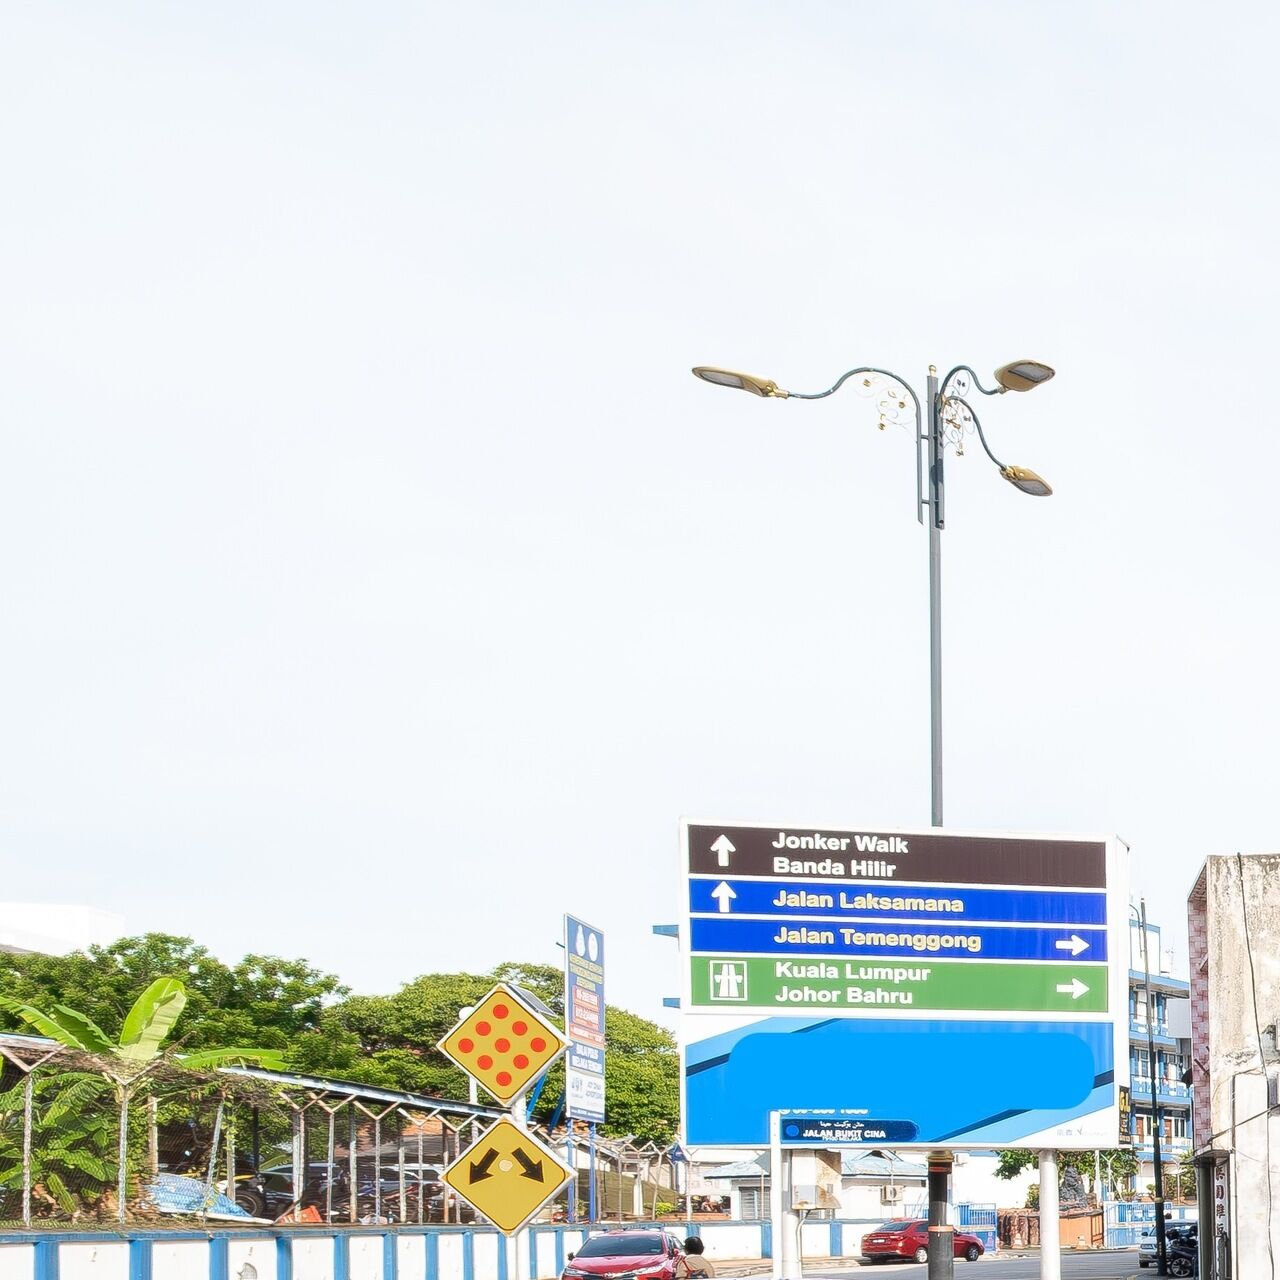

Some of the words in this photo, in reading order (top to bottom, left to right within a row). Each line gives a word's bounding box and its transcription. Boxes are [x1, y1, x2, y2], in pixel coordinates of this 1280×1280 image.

[772, 832, 849, 850] Jonker
[855, 835, 908, 853] Walk
[773, 857, 845, 875] Banda
[850, 860, 896, 877] Hilir
[773, 890, 833, 907] Jalan
[839, 892, 964, 912] Laksamana
[774, 927, 834, 944] Jalan
[839, 928, 982, 952] Temenggong
[775, 962, 839, 979] Kuala
[845, 964, 931, 983] Lumpur
[775, 986, 841, 1003] Johor
[847, 987, 913, 1004] Bahru
[803, 1129, 834, 1138] JALAN
[835, 1129, 862, 1138] BUKIT
[863, 1130, 886, 1138] CINA
